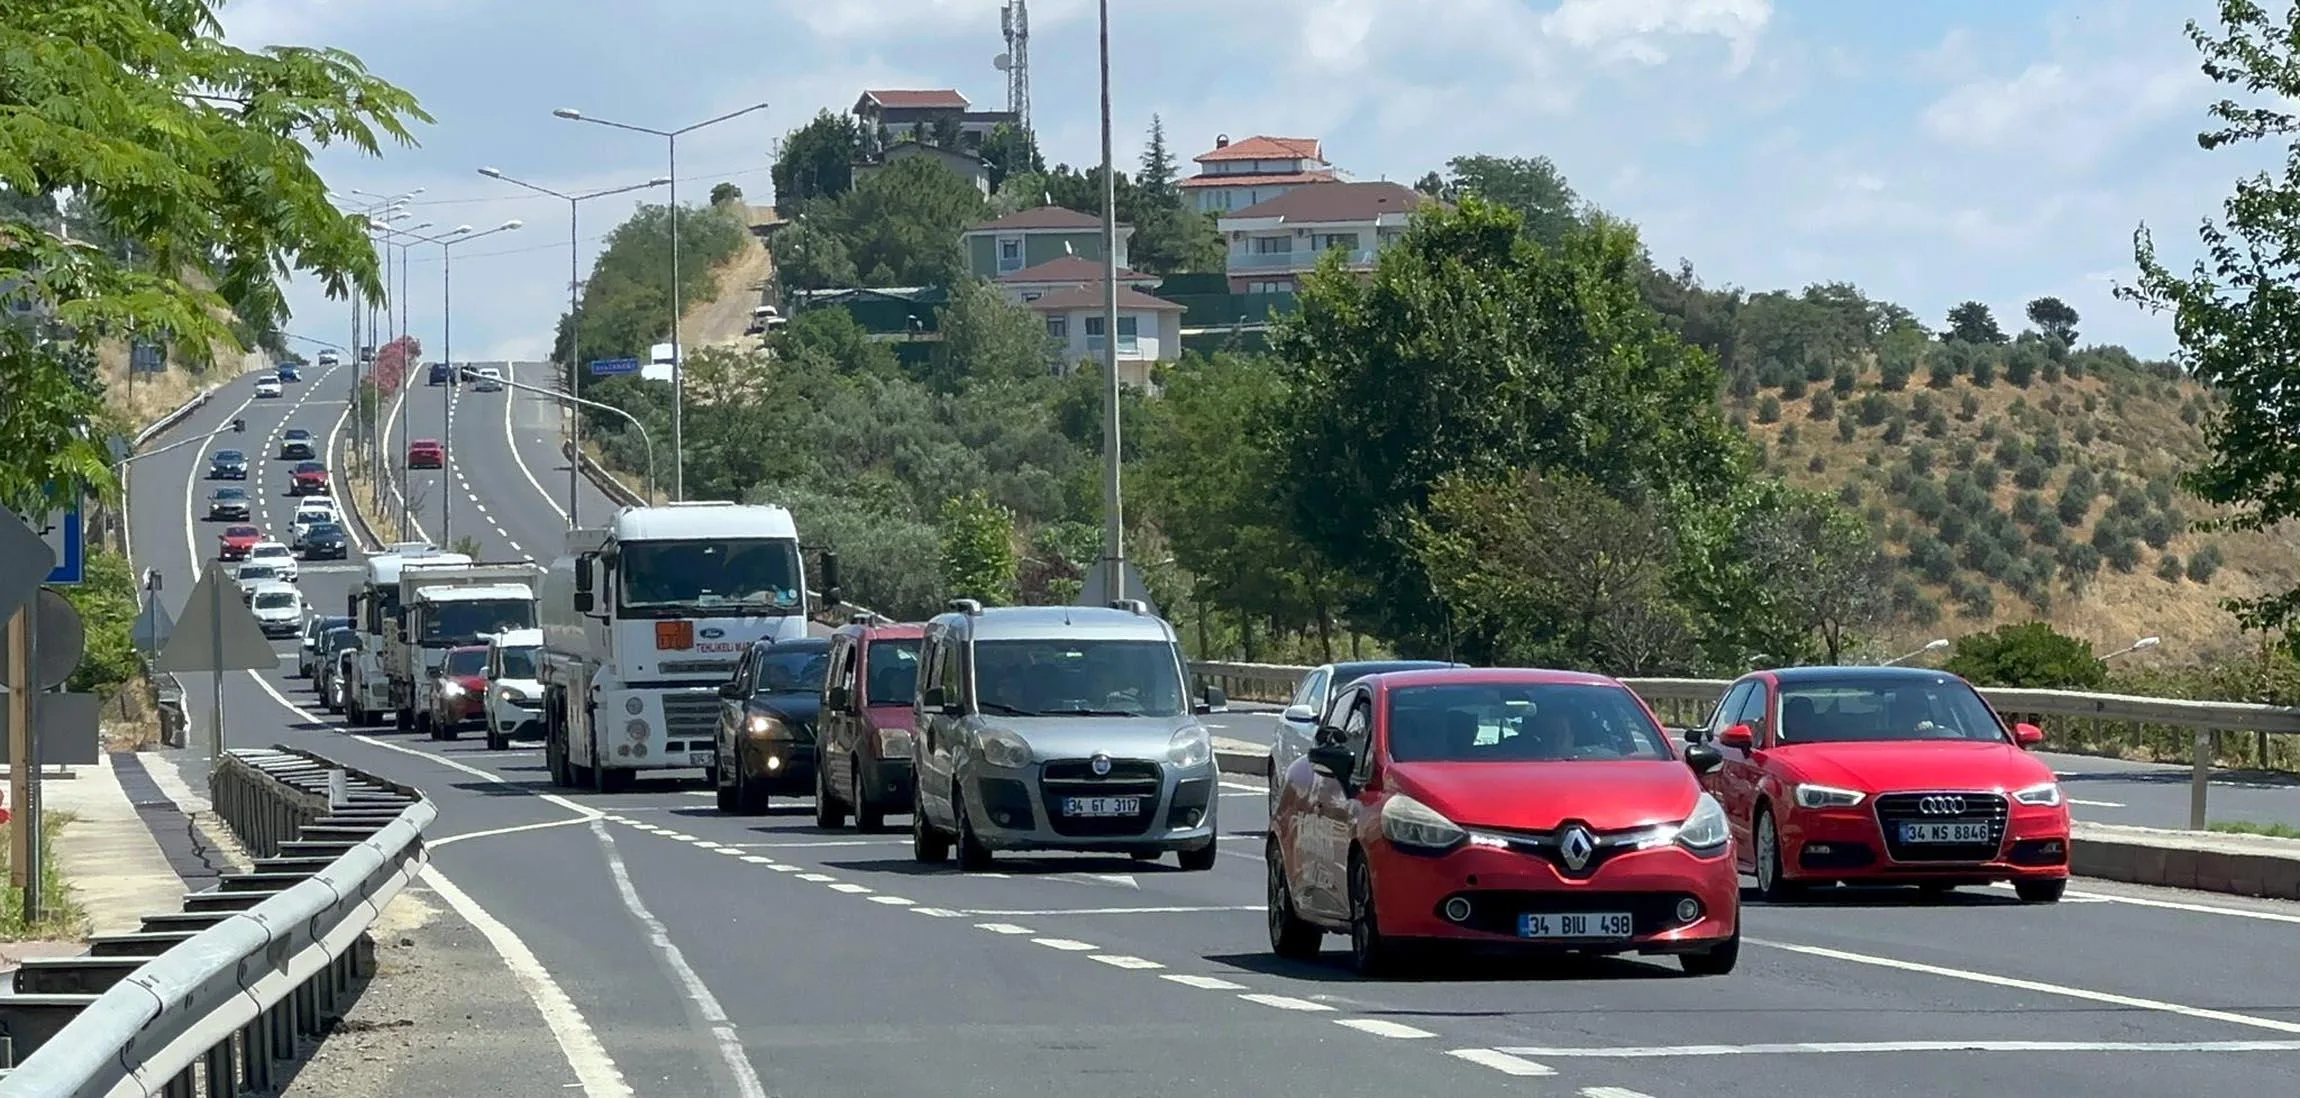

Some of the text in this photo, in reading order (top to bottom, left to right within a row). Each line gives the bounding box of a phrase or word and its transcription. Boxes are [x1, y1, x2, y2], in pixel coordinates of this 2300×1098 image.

[1068, 799, 1138, 812] 34 GT 3117
[1908, 825, 1925, 840] 34
[1954, 825, 1987, 840] 8846
[1529, 915, 1630, 935] 34 BIU 498
